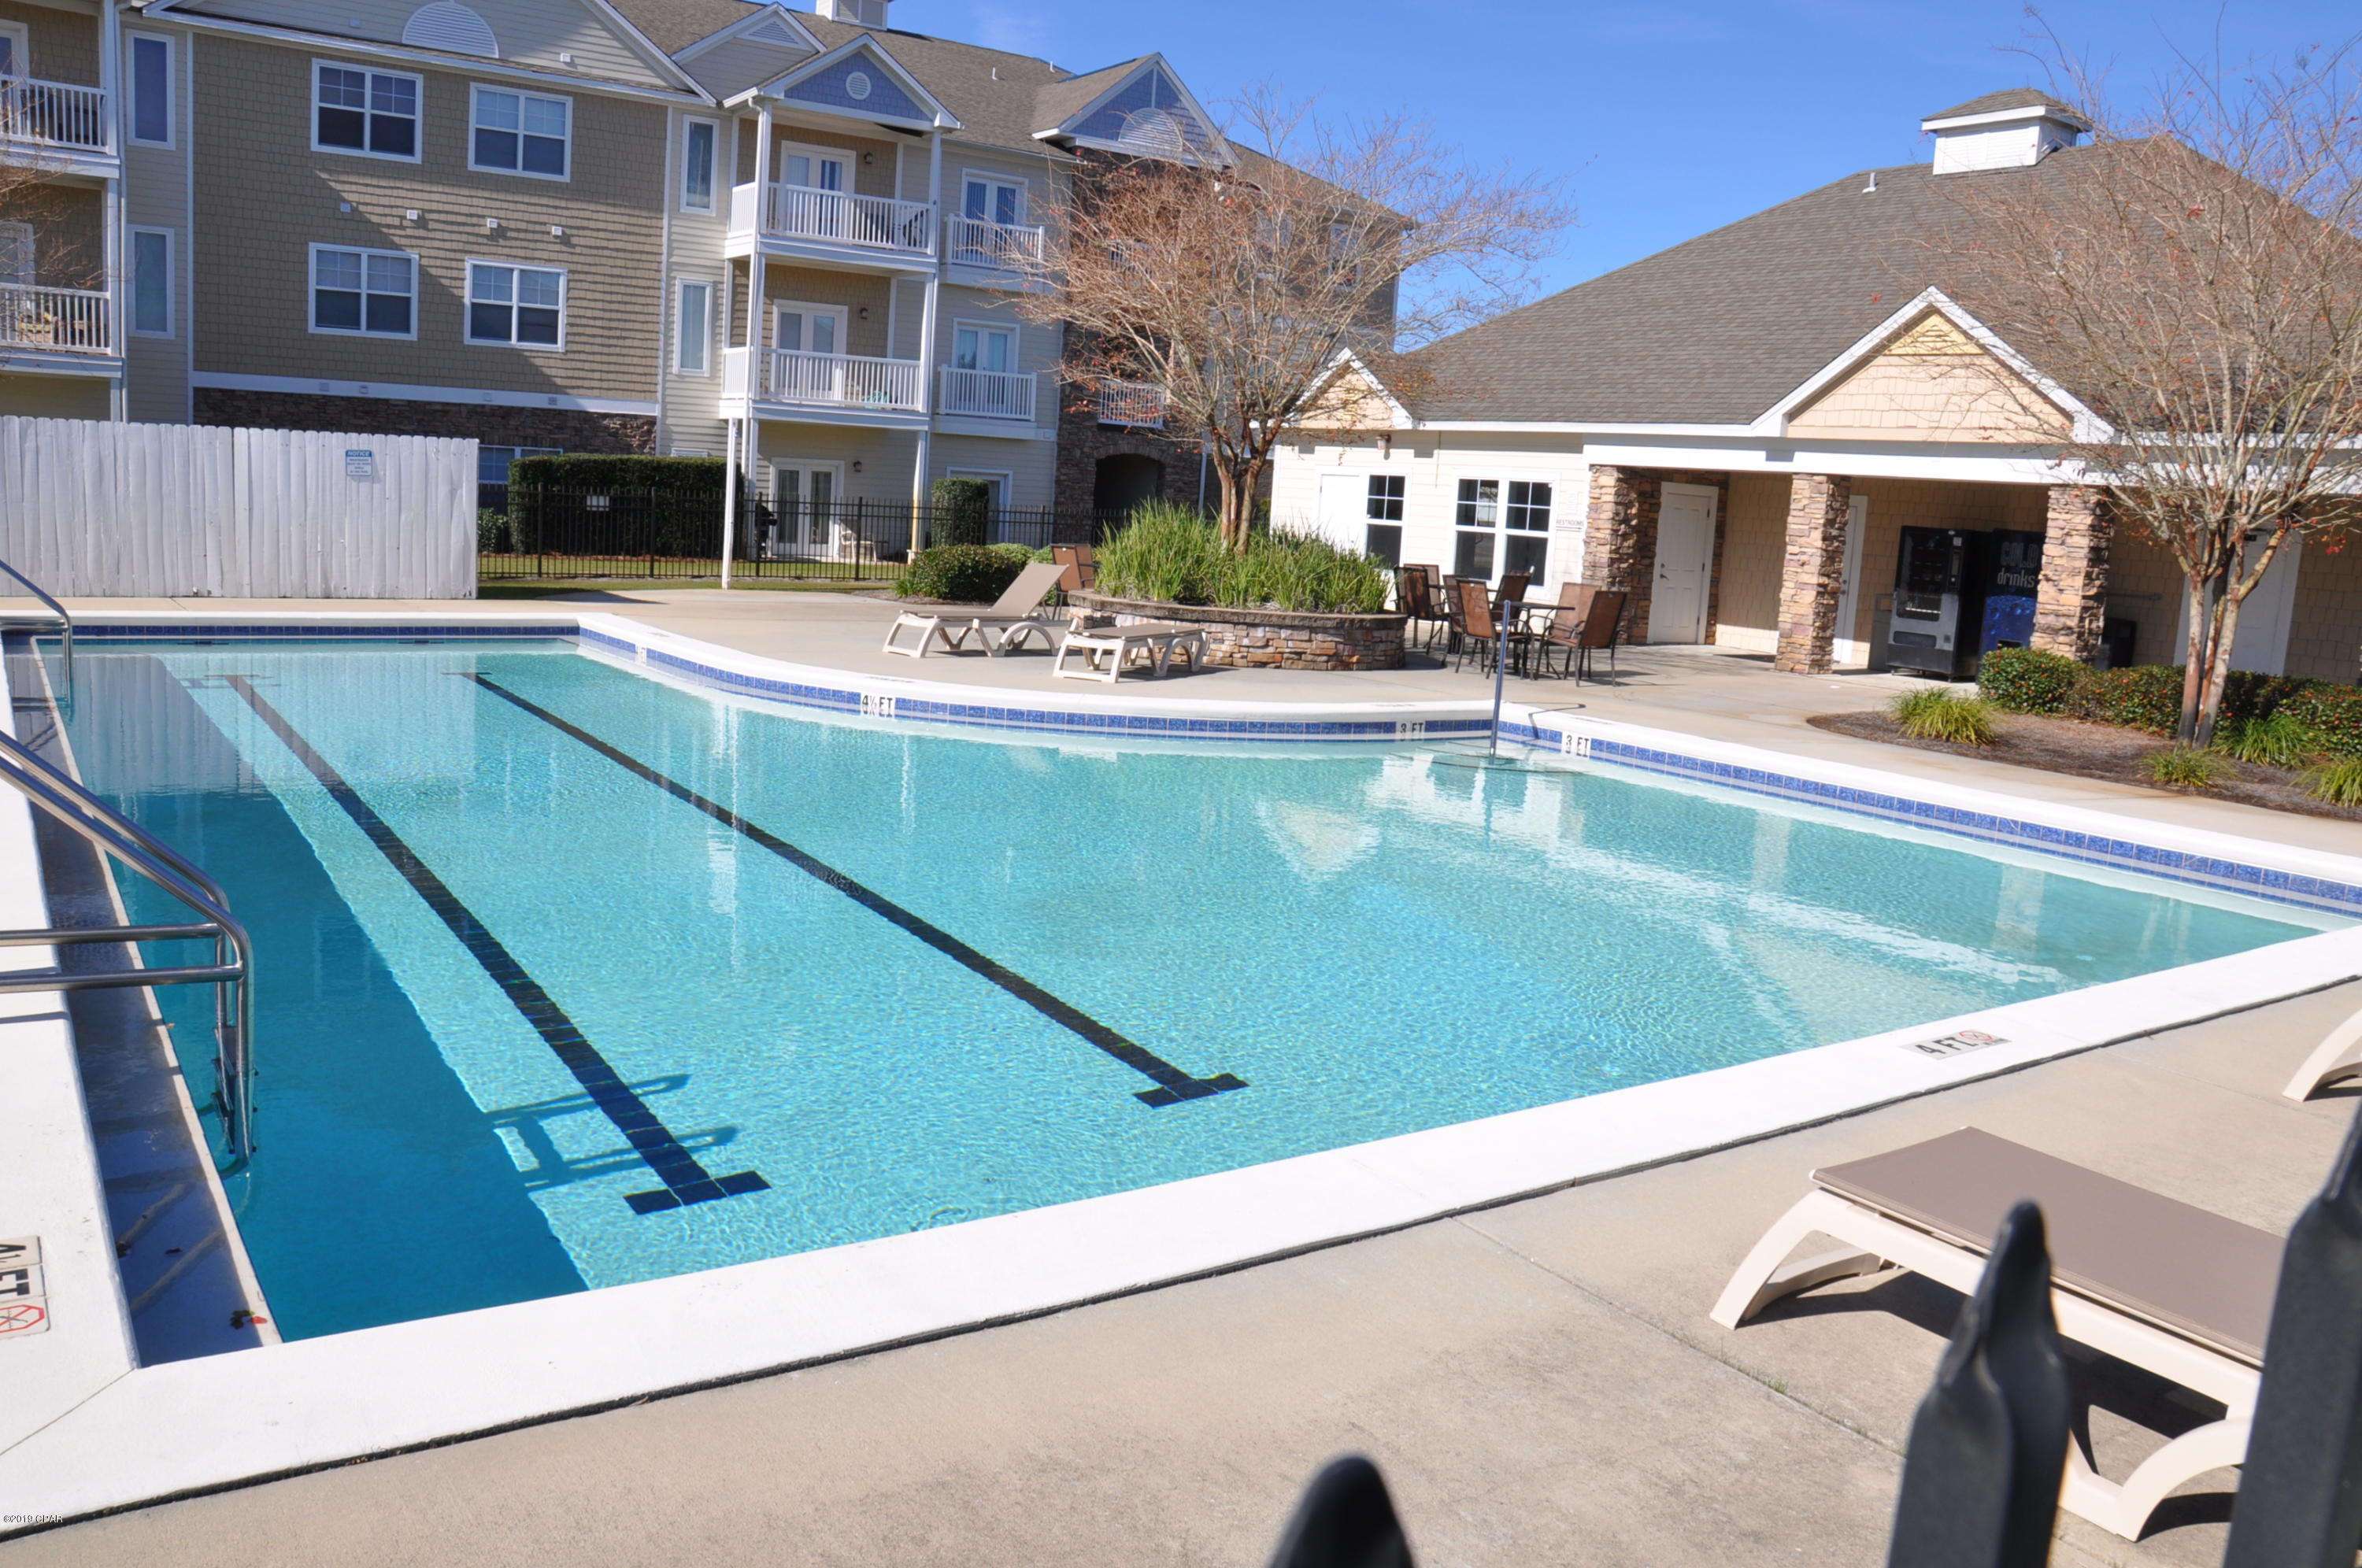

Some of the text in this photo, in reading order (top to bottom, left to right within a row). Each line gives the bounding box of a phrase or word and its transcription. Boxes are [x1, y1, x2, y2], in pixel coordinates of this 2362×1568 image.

[2000, 541, 2039, 568] COLD
[1997, 567, 2035, 588] drinks
[879, 697, 893, 709] FT
[1400, 723, 1424, 734] 3 FT
[1565, 734, 1590, 749] 3 FT
[1914, 1044, 1946, 1055] 4
[1931, 1036, 1979, 1051] FT
